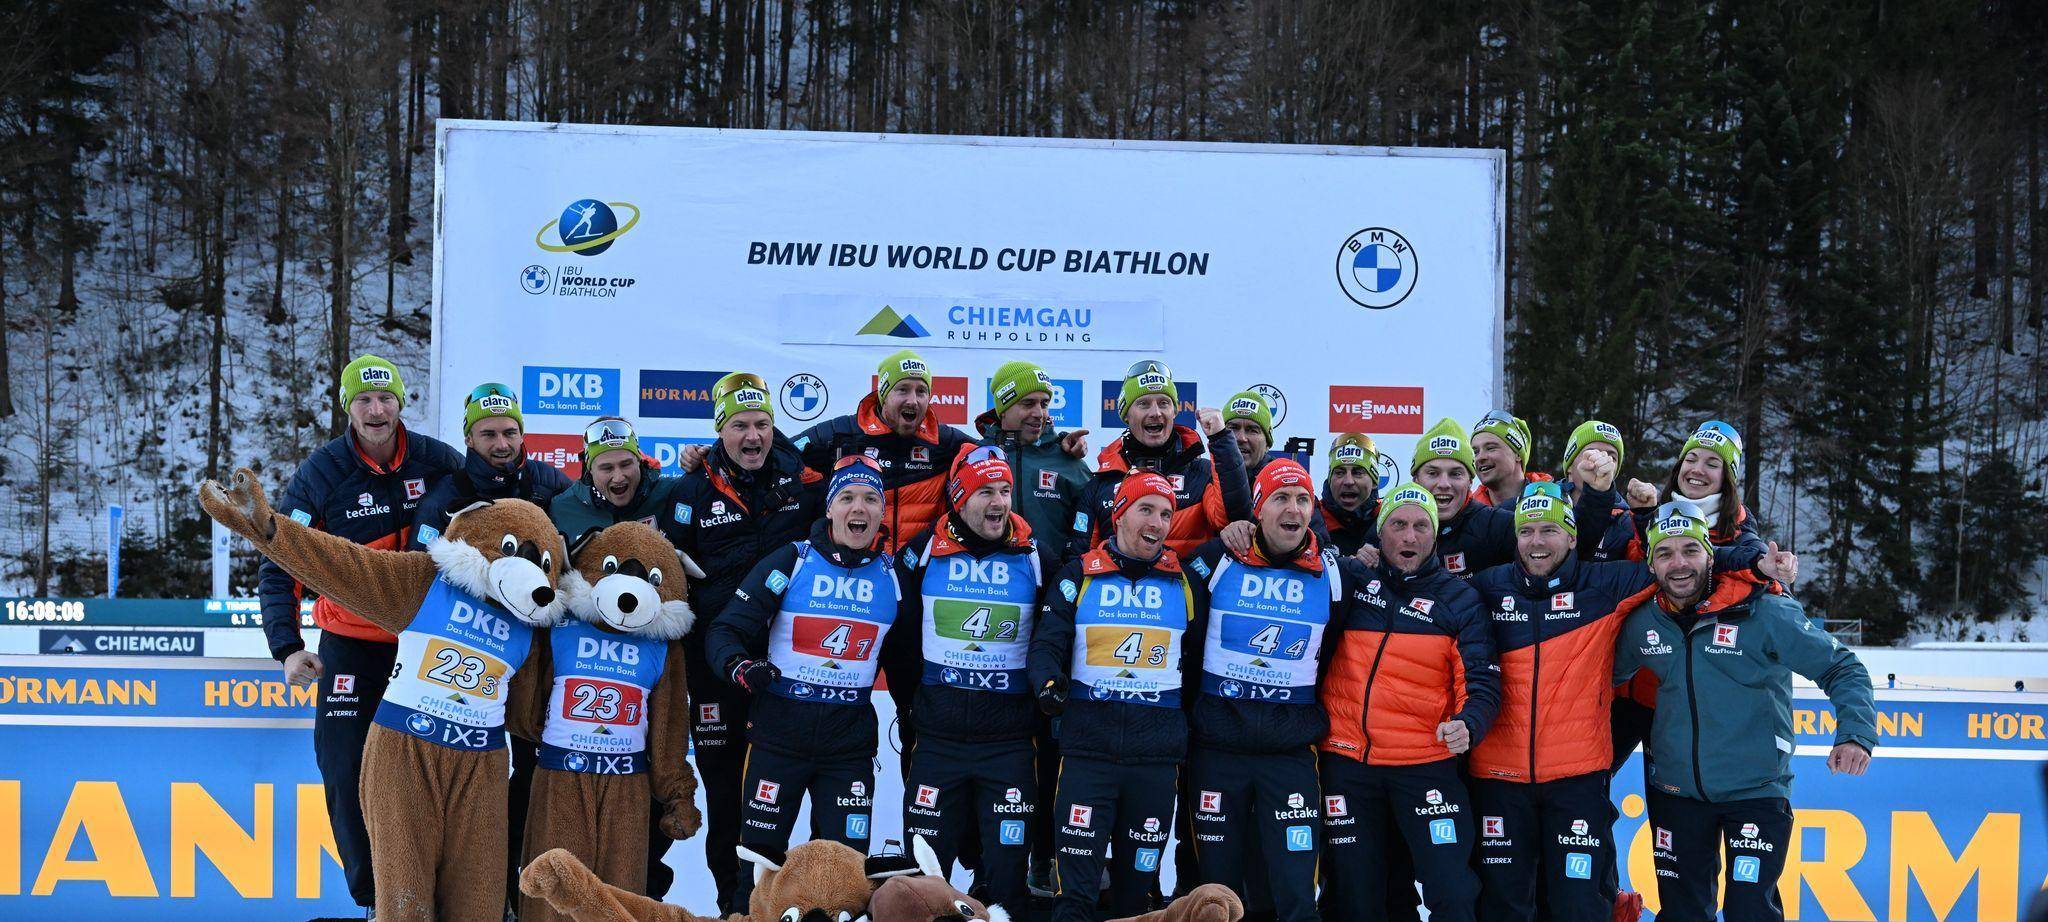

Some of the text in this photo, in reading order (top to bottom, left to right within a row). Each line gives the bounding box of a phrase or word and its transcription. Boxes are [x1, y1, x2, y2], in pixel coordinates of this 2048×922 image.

[1348, 232, 1407, 253] BMW
[748, 241, 1209, 275] BMW IBU WORLD CUP BIATHLON
[564, 266, 583, 275] IBU
[562, 277, 635, 287] WORLD CUP
[560, 287, 617, 298] BIATHLON
[948, 305, 1091, 328] CHIEMGAU
[948, 331, 1091, 343] RUHPOLDING
[902, 360, 926, 371] claro
[362, 368, 390, 381] claro
[1140, 374, 1166, 386] claro
[539, 372, 603, 399] DKB
[788, 376, 822, 389] BMW
[641, 387, 715, 401] HÖRMA
[737, 390, 763, 402] claro
[482, 397, 509, 408] claro
[539, 401, 601, 411] Das kann Bank
[1232, 399, 1257, 410] claro
[1332, 400, 1420, 420] VIESSMANN
[1431, 437, 1457, 449] claro
[1696, 430, 1723, 442] claro
[527, 448, 579, 469] VIESSM
[1337, 446, 1361, 458] claro
[839, 473, 879, 484] robotron
[1034, 490, 1060, 499] Kaufland
[1394, 489, 1427, 502] claro
[346, 503, 390, 519] tectake
[1522, 498, 1549, 510] claro
[700, 512, 742, 528] tectake
[1660, 518, 1689, 531] claro
[949, 558, 1009, 584] DKB
[812, 575, 874, 602] DKB
[947, 584, 1008, 596] Das kann Bank
[1240, 574, 1303, 603] DKB
[1100, 584, 1162, 609] DKB
[1355, 590, 1387, 608] tectake
[6, 601, 84, 621] 16:08:08
[809, 600, 871, 614] Das kann Bank
[1237, 600, 1301, 615] Das kann Bank
[451, 601, 510, 641] DKB
[1098, 610, 1161, 620] Das kann Bank
[1400, 607, 1433, 623] Kaufland
[1492, 611, 1528, 621] tectake
[1545, 611, 1580, 620] Kaufland
[961, 607, 992, 639] 4
[95, 636, 195, 652] CHIEMGAU
[446, 624, 505, 652] Das kann Bank
[821, 624, 853, 656] 4
[1249, 624, 1283, 655] 4
[577, 637, 639, 665] DKB
[1114, 632, 1143, 664] 4
[1640, 644, 1672, 655] tectake
[1705, 646, 1742, 655] Kaufland
[945, 650, 1006, 662] CHIEMGAU
[427, 648, 485, 689] 23
[576, 662, 637, 677] Das kann Bank
[944, 660, 1006, 668] RUHPOLDING
[1227, 663, 1291, 679] CHIEMGAU
[800, 666, 859, 680] CHIEMGAU
[1226, 672, 1290, 685] RUHPOLDING
[797, 675, 858, 686] RUHPOLDING
[969, 672, 1009, 689] iX3
[205, 678, 318, 707] HÖRM
[421, 696, 488, 719] CHIEMGAU
[571, 684, 621, 720] 23
[418, 704, 487, 726] RUHPOLDING
[1968, 712, 2046, 739] HÖR
[443, 724, 488, 747] iX3
[571, 733, 632, 746] CHIEMGAU
[570, 743, 632, 751] RUHPOLDING
[596, 756, 633, 774] iX3
[749, 800, 780, 813] Kaufland
[909, 806, 940, 817] Kaufland
[994, 802, 1034, 813] tectake
[1275, 807, 1317, 820] tectake
[1415, 802, 1459, 816] tectake
[752, 820, 777, 830] TERREX
[851, 817, 866, 835] TQ
[914, 827, 938, 836] TERREX
[1062, 826, 1095, 838] Kaufland
[1435, 823, 1452, 840] TQ
[1005, 824, 1021, 842] TQ
[1291, 829, 1308, 847] TQ
[1332, 837, 1356, 845] TERREX
[1558, 834, 1600, 847] tectake
[1730, 838, 1773, 852] tectake
[1067, 847, 1092, 856] TERREX
[1654, 851, 1677, 862] aufland
[1141, 852, 1155, 868] TQ
[1570, 856, 1587, 875] TQ
[1739, 860, 1755, 879] TQ
